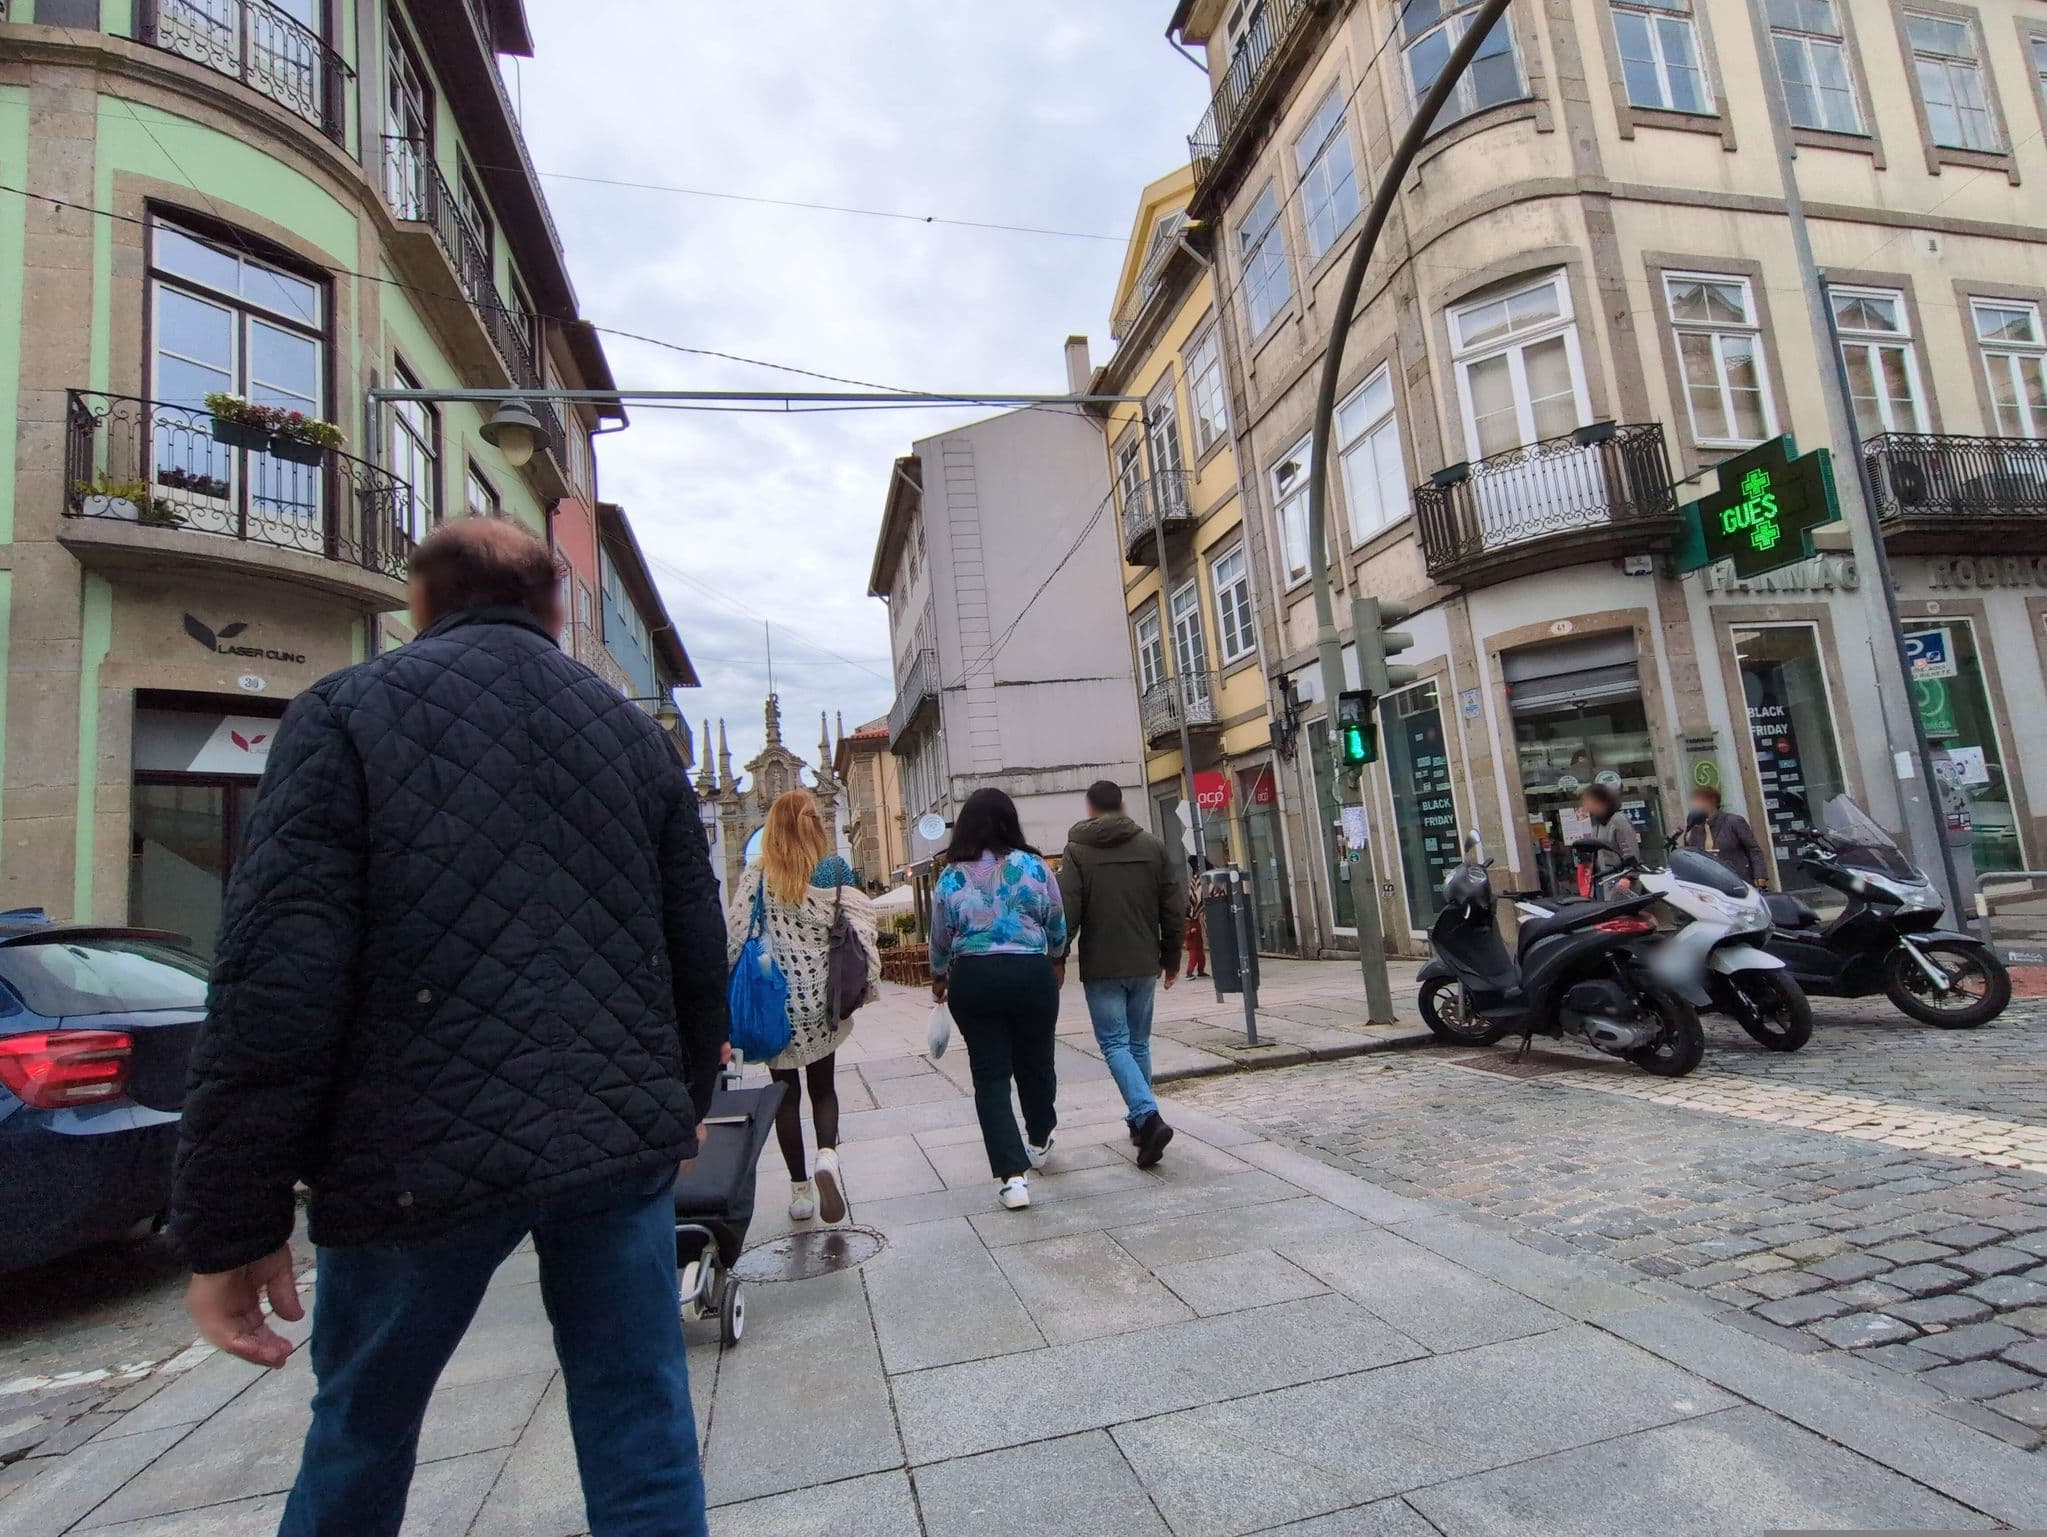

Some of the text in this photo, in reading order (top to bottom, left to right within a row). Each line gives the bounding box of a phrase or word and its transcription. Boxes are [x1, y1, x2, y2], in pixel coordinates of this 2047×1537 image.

[1720, 493, 1778, 534] GUES
[218, 645, 264, 658] LASER
[1747, 706, 1785, 718] BLACK
[1751, 723, 1788, 736] FRIDAY
[1422, 798, 1451, 811] BLACK
[1424, 815, 1454, 827] FRIDAY
